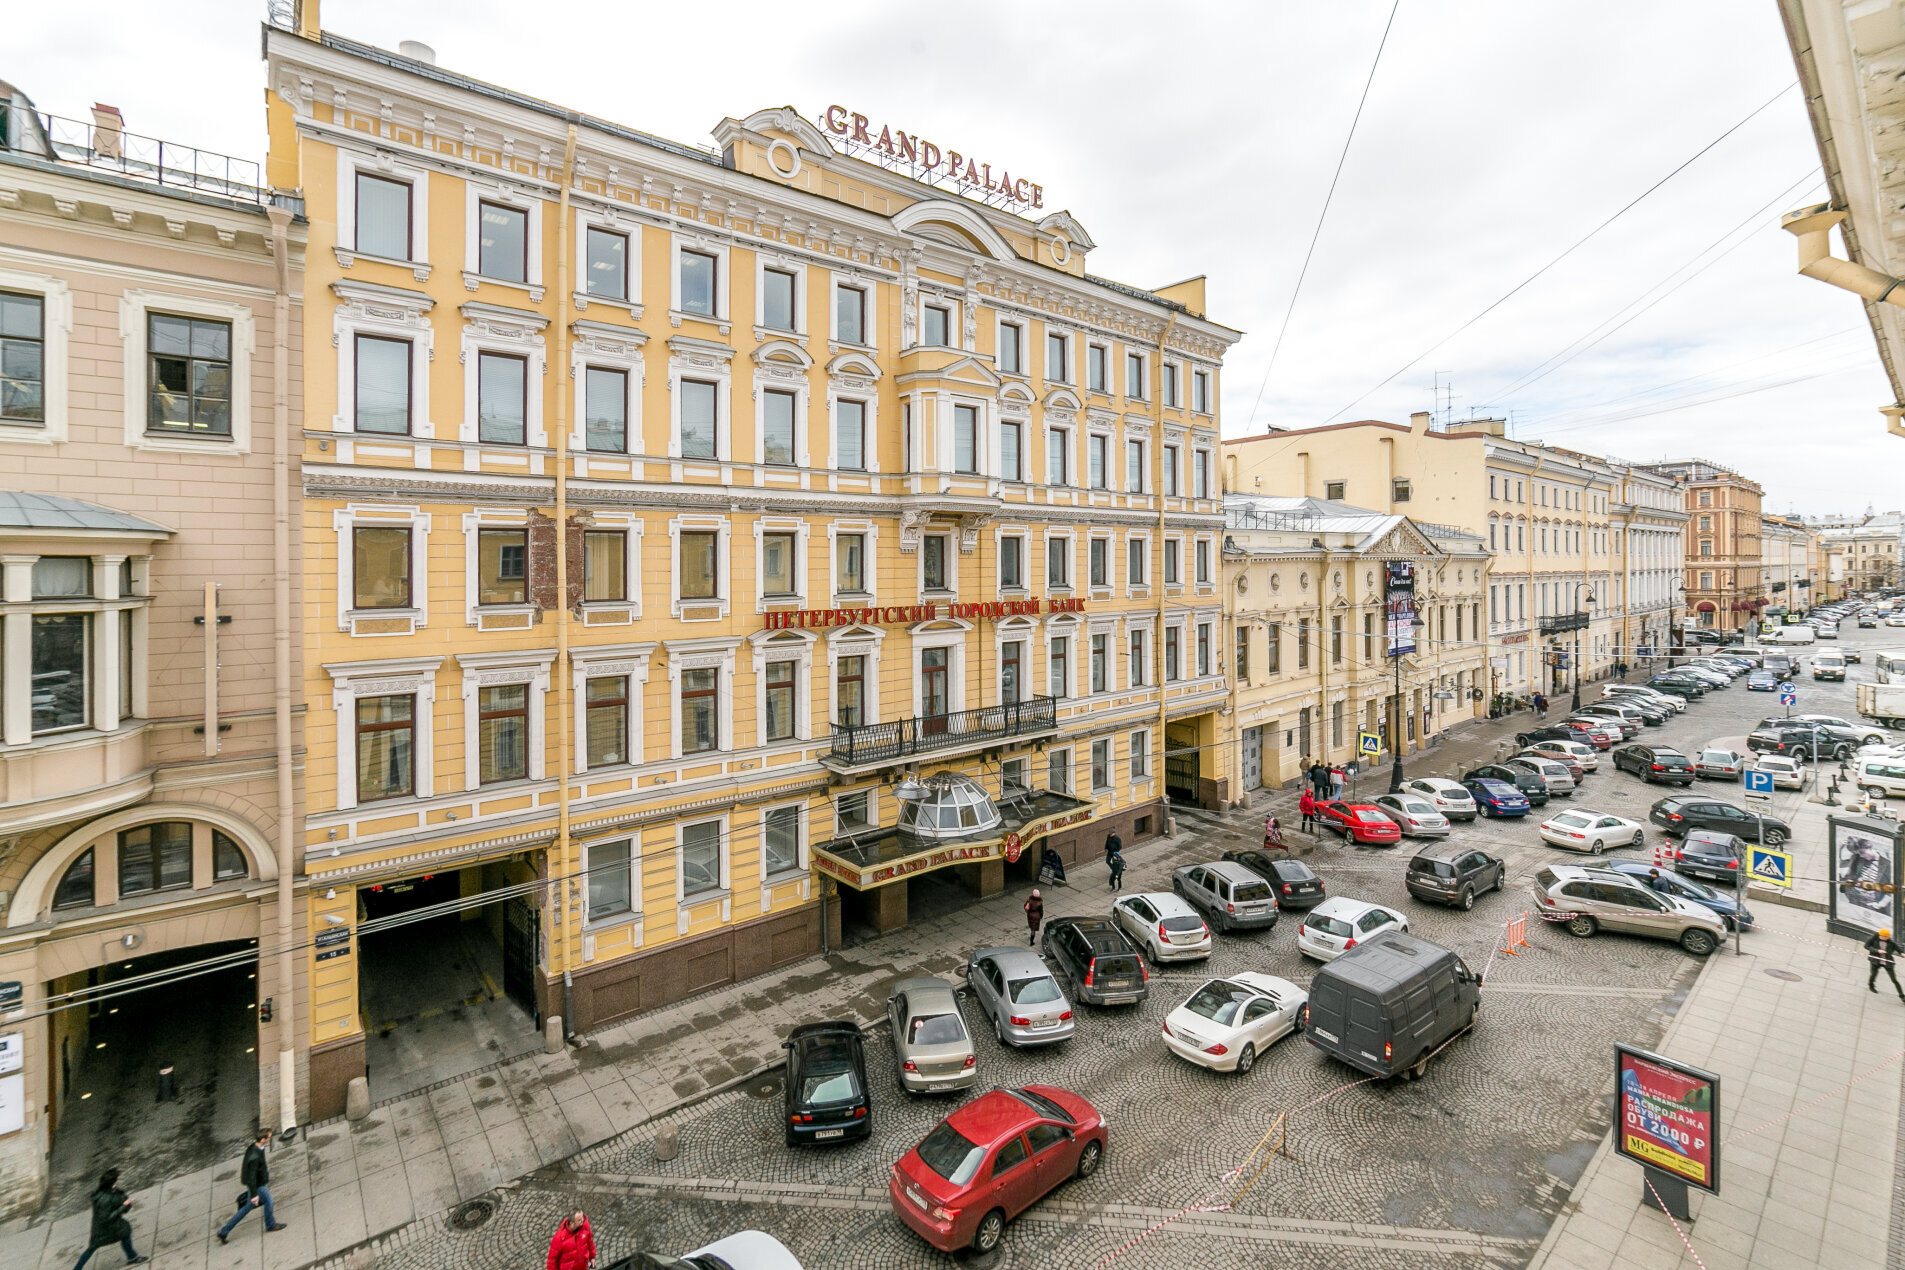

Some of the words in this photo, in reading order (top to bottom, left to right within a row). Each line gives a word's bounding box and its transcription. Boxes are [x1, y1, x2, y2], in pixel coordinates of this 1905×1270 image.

[824, 104, 941, 169] GRAND
[947, 150, 1043, 209] PALACE
[764, 600, 936, 630] ПЕТЕРБУРГСКИЙ
[949, 596, 1040, 621] ГОРОДСКОЙ
[1050, 598, 1086, 613] БАНК
[1752, 773, 1768, 789] P
[872, 857, 927, 882] GRAND
[931, 846, 990, 867] PALACE
[1627, 1085, 1650, 1098] MANIA
[1652, 1095, 1694, 1115] GRANDIOSA
[1648, 1088, 1677, 1102] АПРЕЛЯ
[1627, 1103, 1661, 1122] ОБУВИ
[1627, 1095, 1704, 1131] РАСПРОДАЖА
[1627, 1112, 1647, 1127] ОТ
[1650, 1121, 1689, 1145] 2000
[1630, 1137, 1649, 1153] MG
